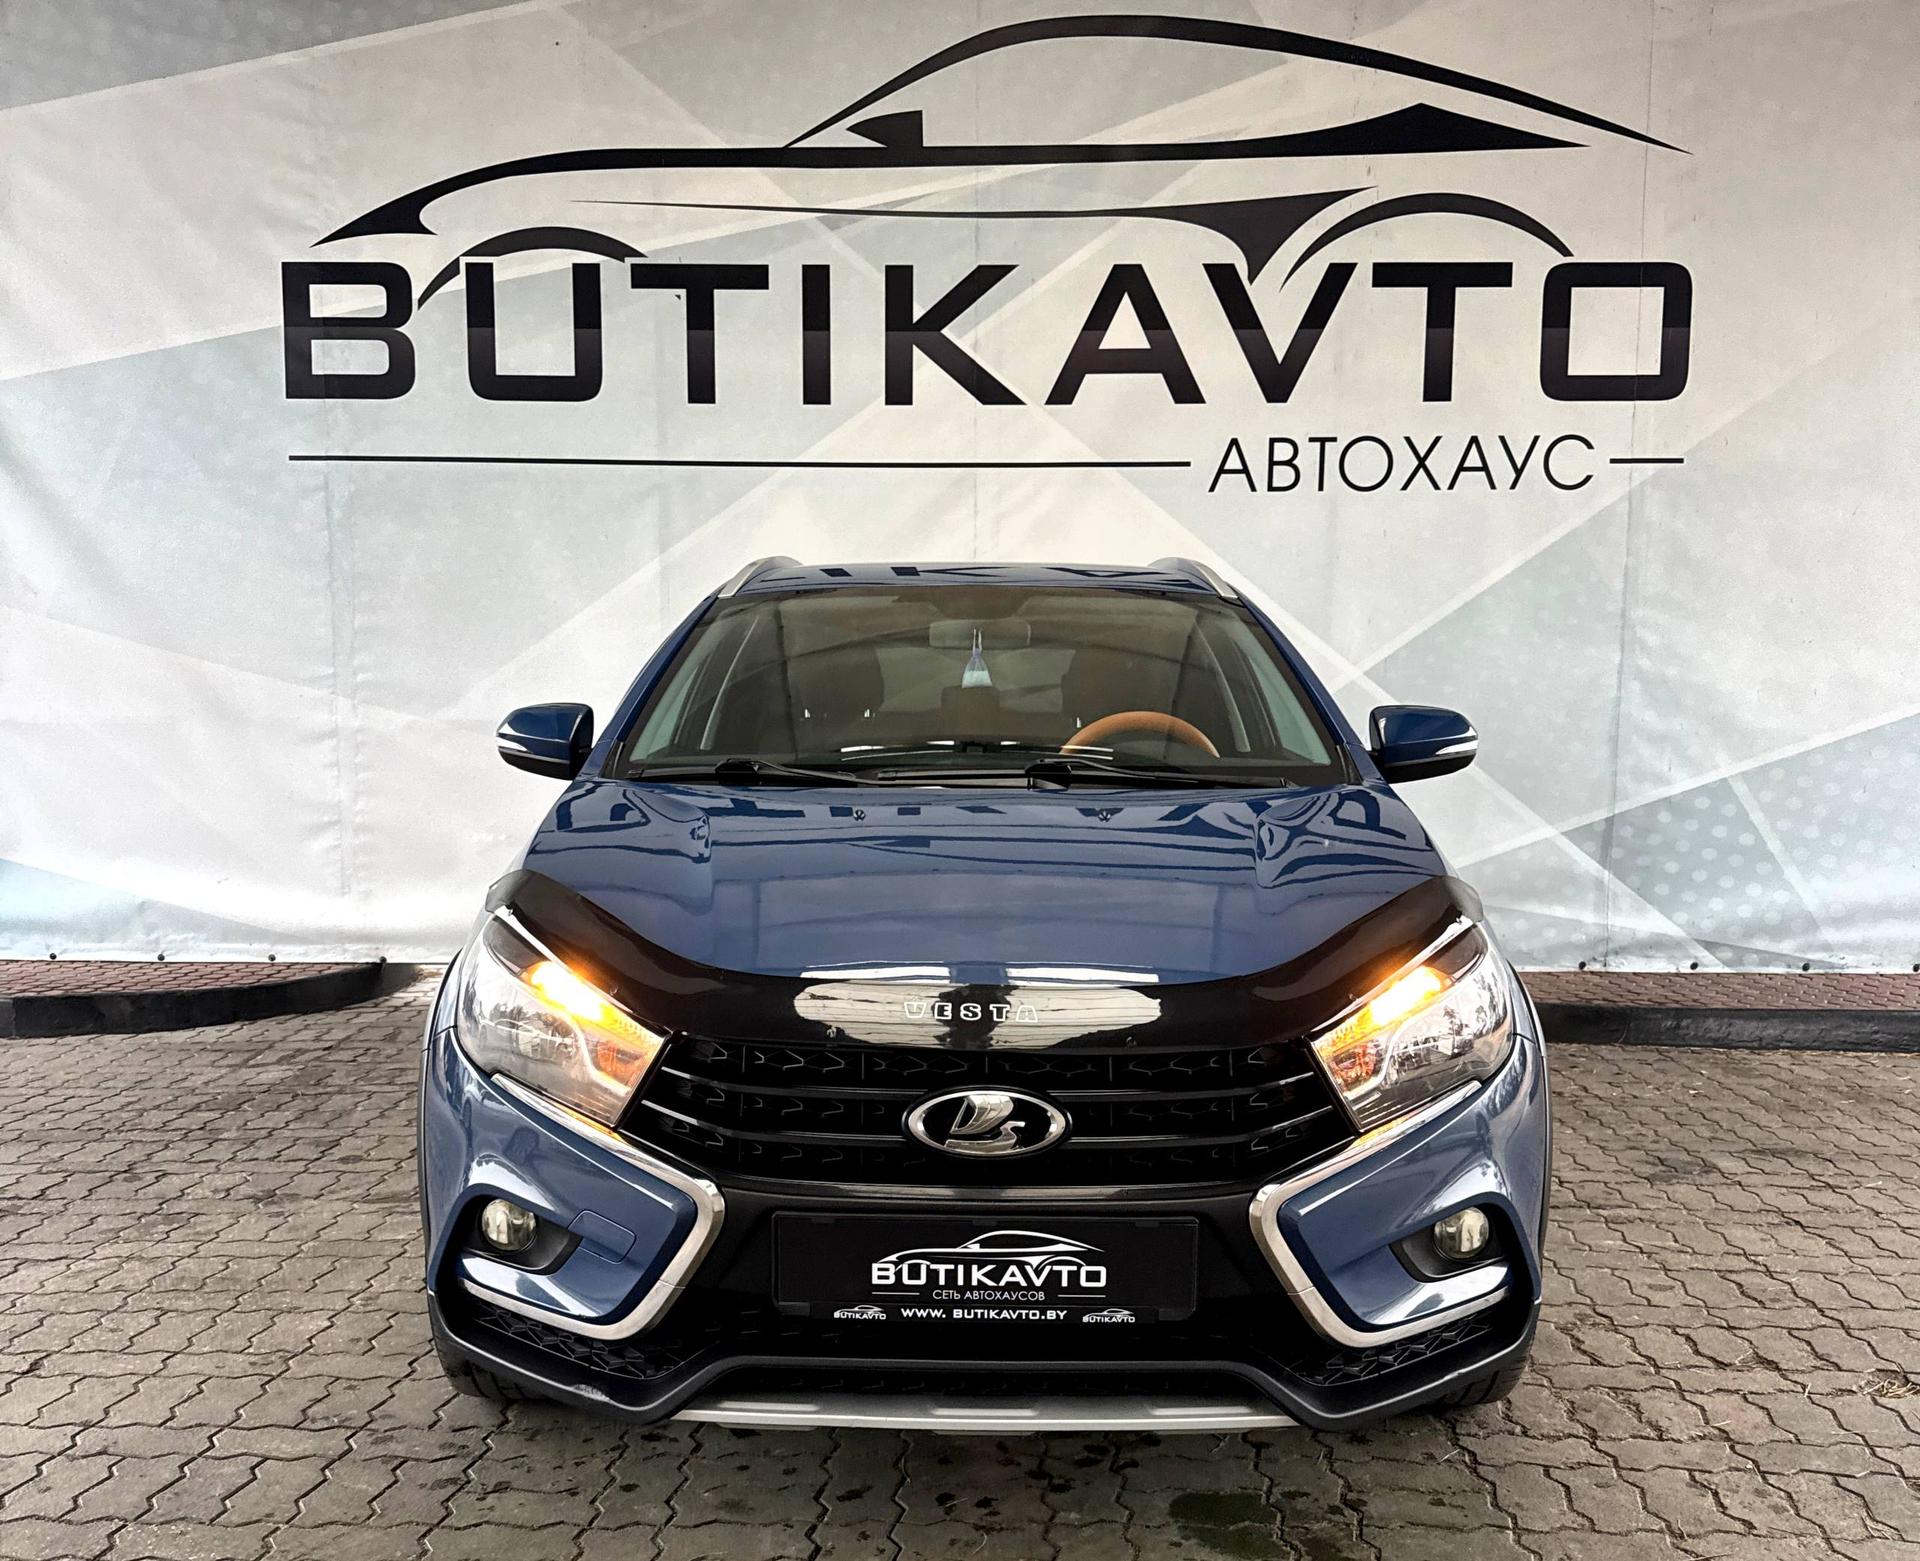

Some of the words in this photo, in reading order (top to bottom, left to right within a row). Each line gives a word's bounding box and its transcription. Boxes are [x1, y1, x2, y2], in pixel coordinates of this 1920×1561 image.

[281, 260, 1693, 406] BUTIKAVTO
[1207, 433, 1596, 493] АВТОХАУС
[903, 1001, 1039, 1023] VESTA
[871, 1262, 1107, 1288] BUTIKAVTO
[932, 1289, 961, 1300] СЕТЬ
[963, 1290, 1046, 1301] АВТОХАУСОВ
[833, 1311, 887, 1320] BUTIKAVTO
[1082, 1315, 1136, 1323] BUTIKAVTO
